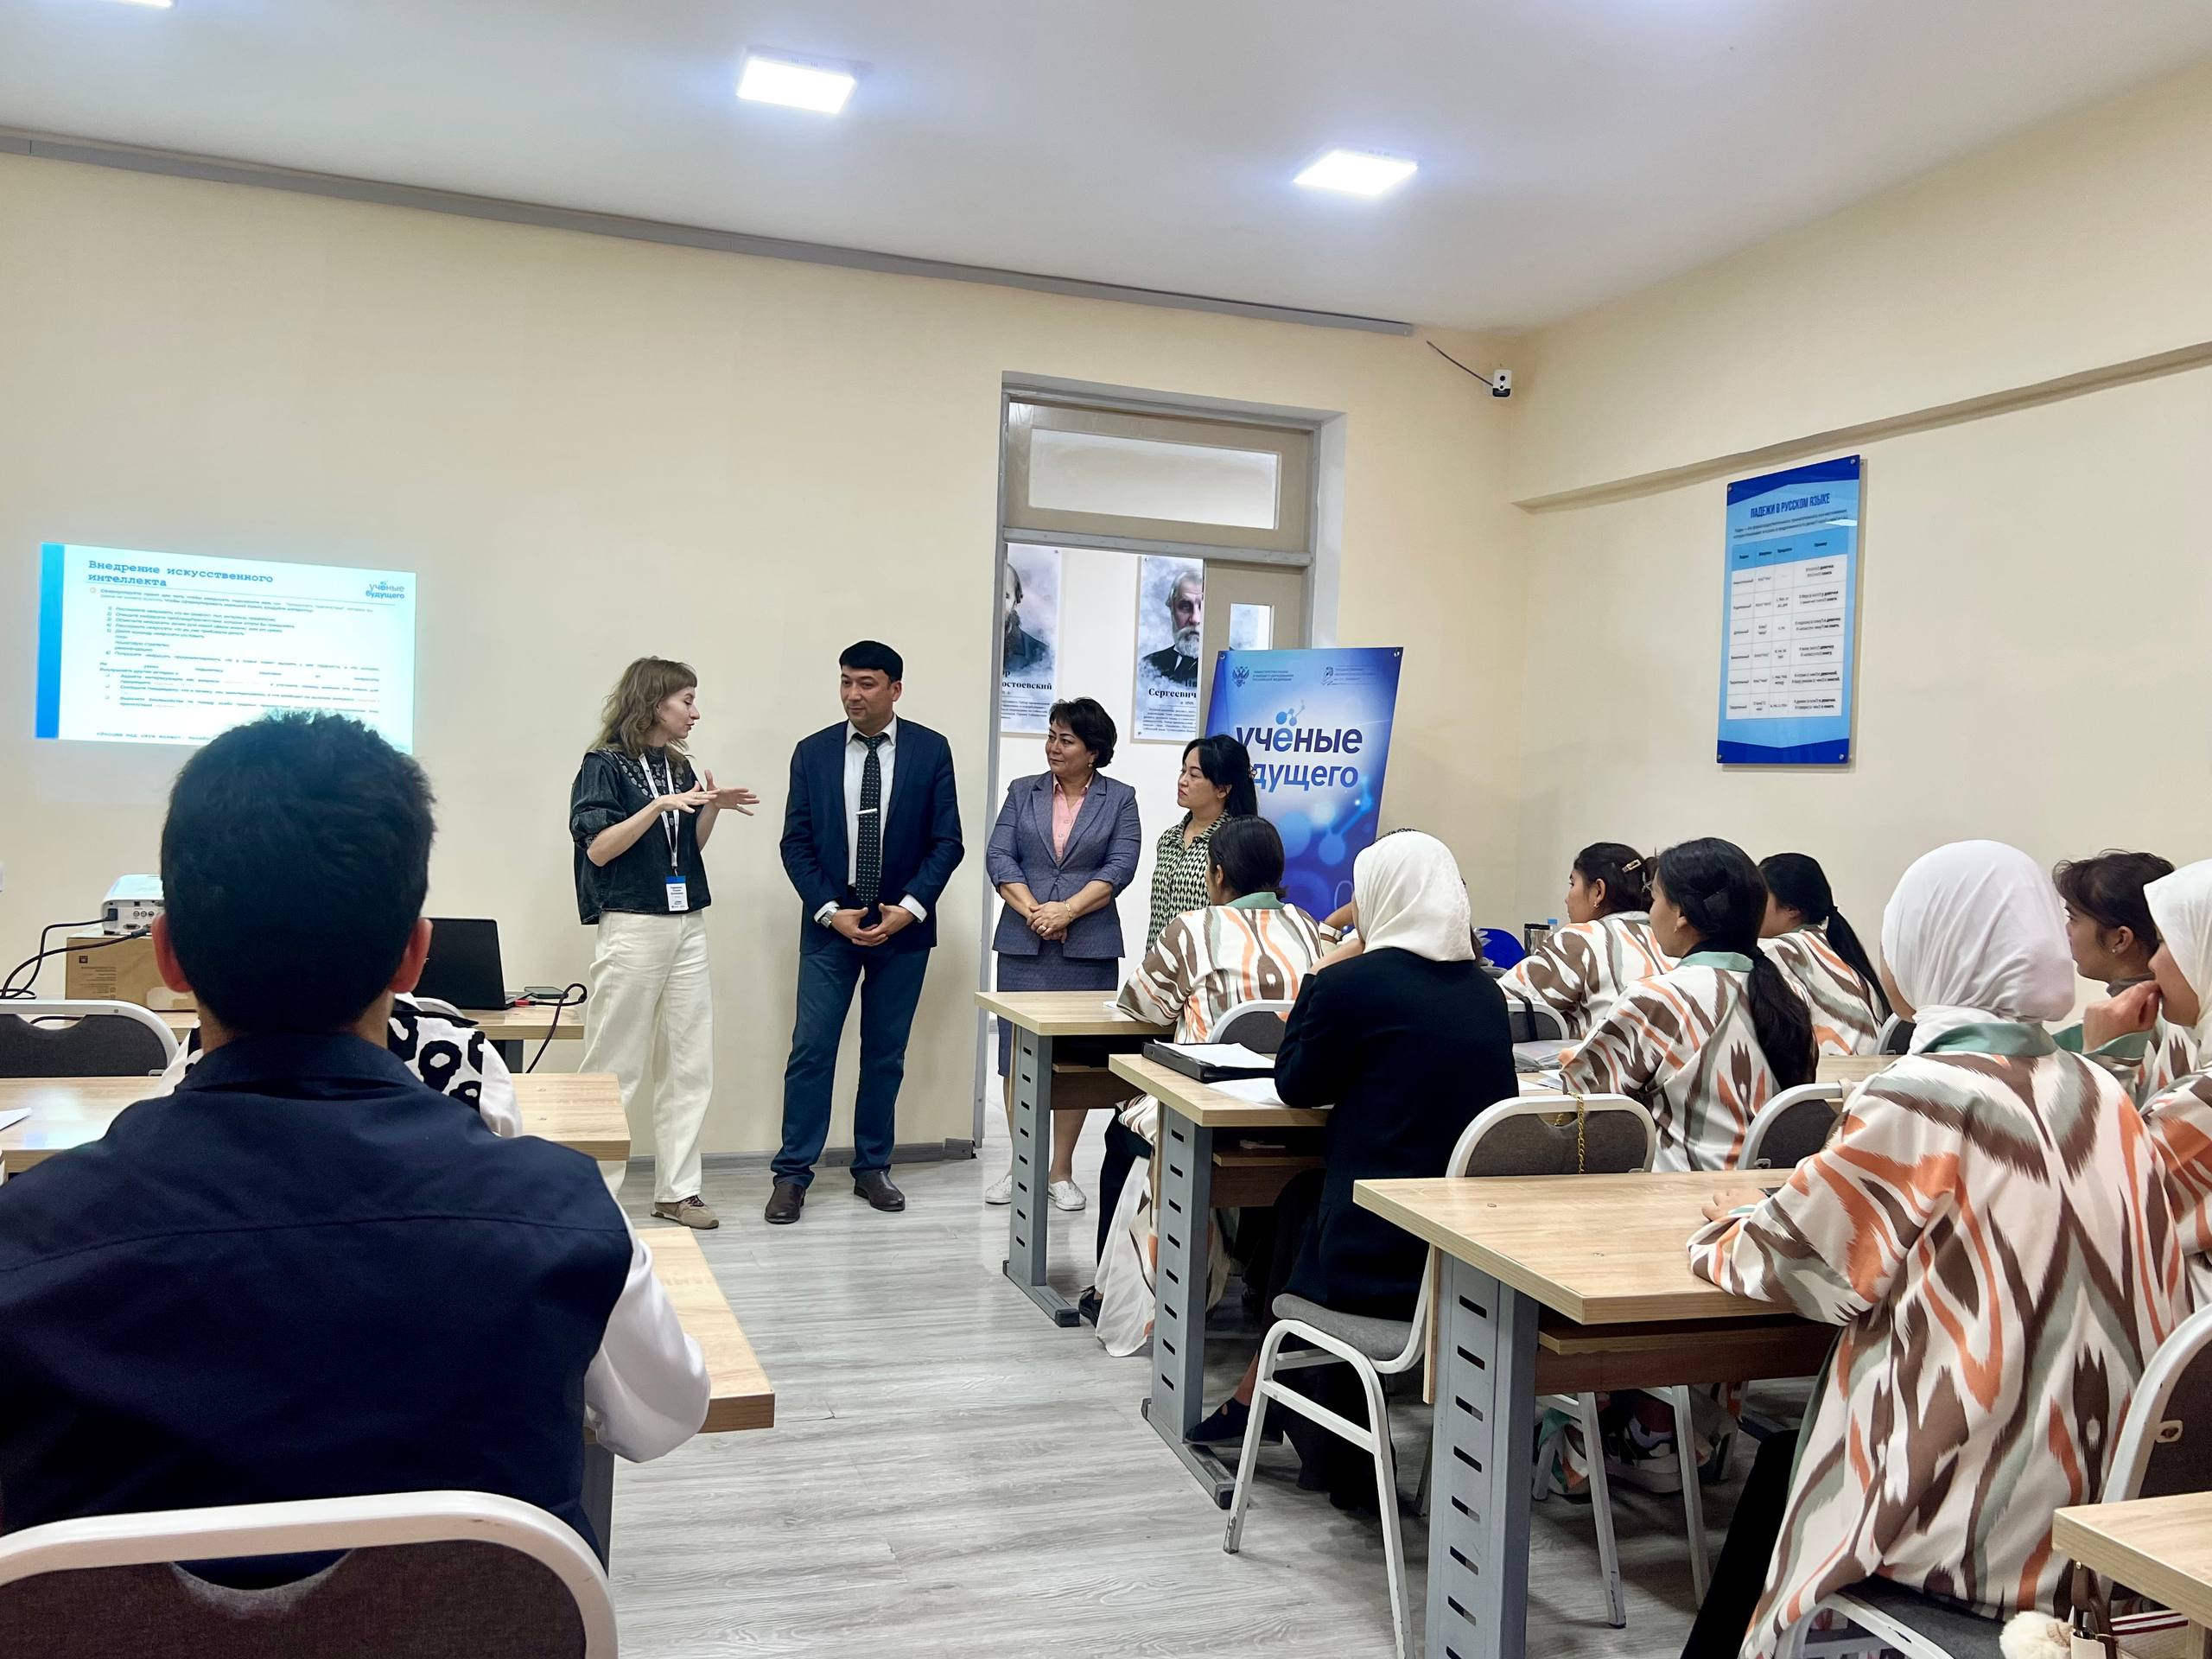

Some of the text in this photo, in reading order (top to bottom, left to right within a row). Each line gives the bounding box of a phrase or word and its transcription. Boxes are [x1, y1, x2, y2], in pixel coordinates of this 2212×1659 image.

[1750, 505, 1776, 518] ПАДЕЖИ
[1781, 498, 1808, 512] РУССКОМ
[1809, 493, 1830, 506] ЯЗЫКЕ
[88, 560, 273, 583] Внедрение искусственного
[88, 574, 167, 587] интеллекта
[365, 591, 405, 600] будущего
[1001, 681, 1052, 690] остоевский
[1148, 688, 1197, 698] Сергеевич
[1236, 712, 1363, 753] учёные
[1253, 763, 1359, 792] дущего
